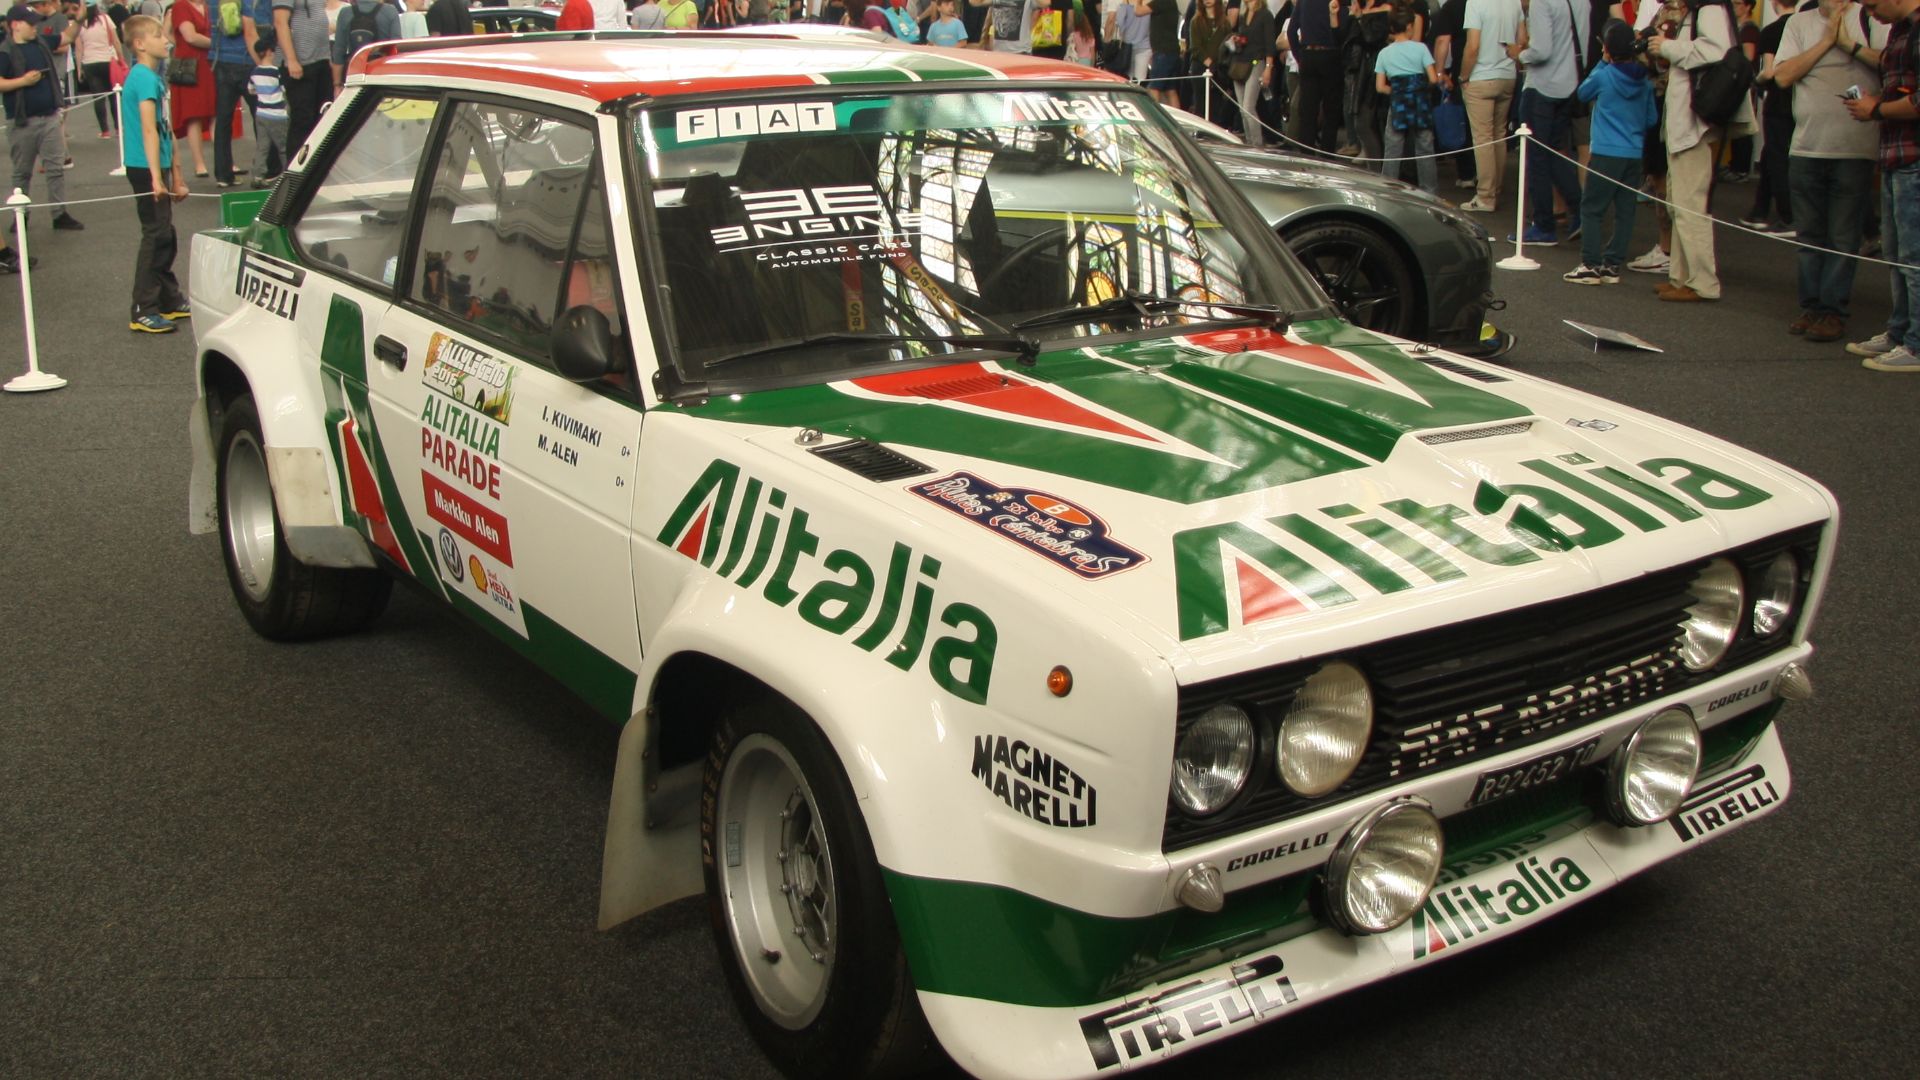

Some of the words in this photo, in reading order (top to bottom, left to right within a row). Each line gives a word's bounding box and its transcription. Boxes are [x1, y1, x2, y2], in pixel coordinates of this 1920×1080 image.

[686, 106, 827, 136] FIAT
[1003, 94, 1146, 121] Alitalia
[756, 245, 849, 261] CLASSIC
[858, 241, 913, 252] CARS
[771, 255, 864, 269] AUTOMOBILE
[869, 251, 907, 260] FUND
[235, 247, 307, 321] PIRELLI
[432, 365, 458, 388] 2016
[421, 394, 500, 460] ALITALIA
[538, 434, 549, 453] M.
[551, 442, 579, 467] ALEN
[542, 405, 549, 422] I.
[551, 410, 602, 447] KIVIMAKI
[421, 427, 501, 501] PARADE
[434, 489, 472, 528] Markku
[475, 515, 500, 545] Alen
[1043, 504, 1070, 515] B
[1172, 457, 1773, 641] Alitalia
[656, 458, 998, 706] Alitalia
[1707, 679, 1770, 713] CARELLO
[971, 734, 1096, 804] MAGNETI
[971, 764, 1096, 828] MARELLI
[1667, 763, 1780, 843] PIRELLI
[1226, 832, 1329, 873] CARELLO
[1411, 856, 1592, 960] Alitalia
[1078, 954, 1299, 1071] PIRELLI
